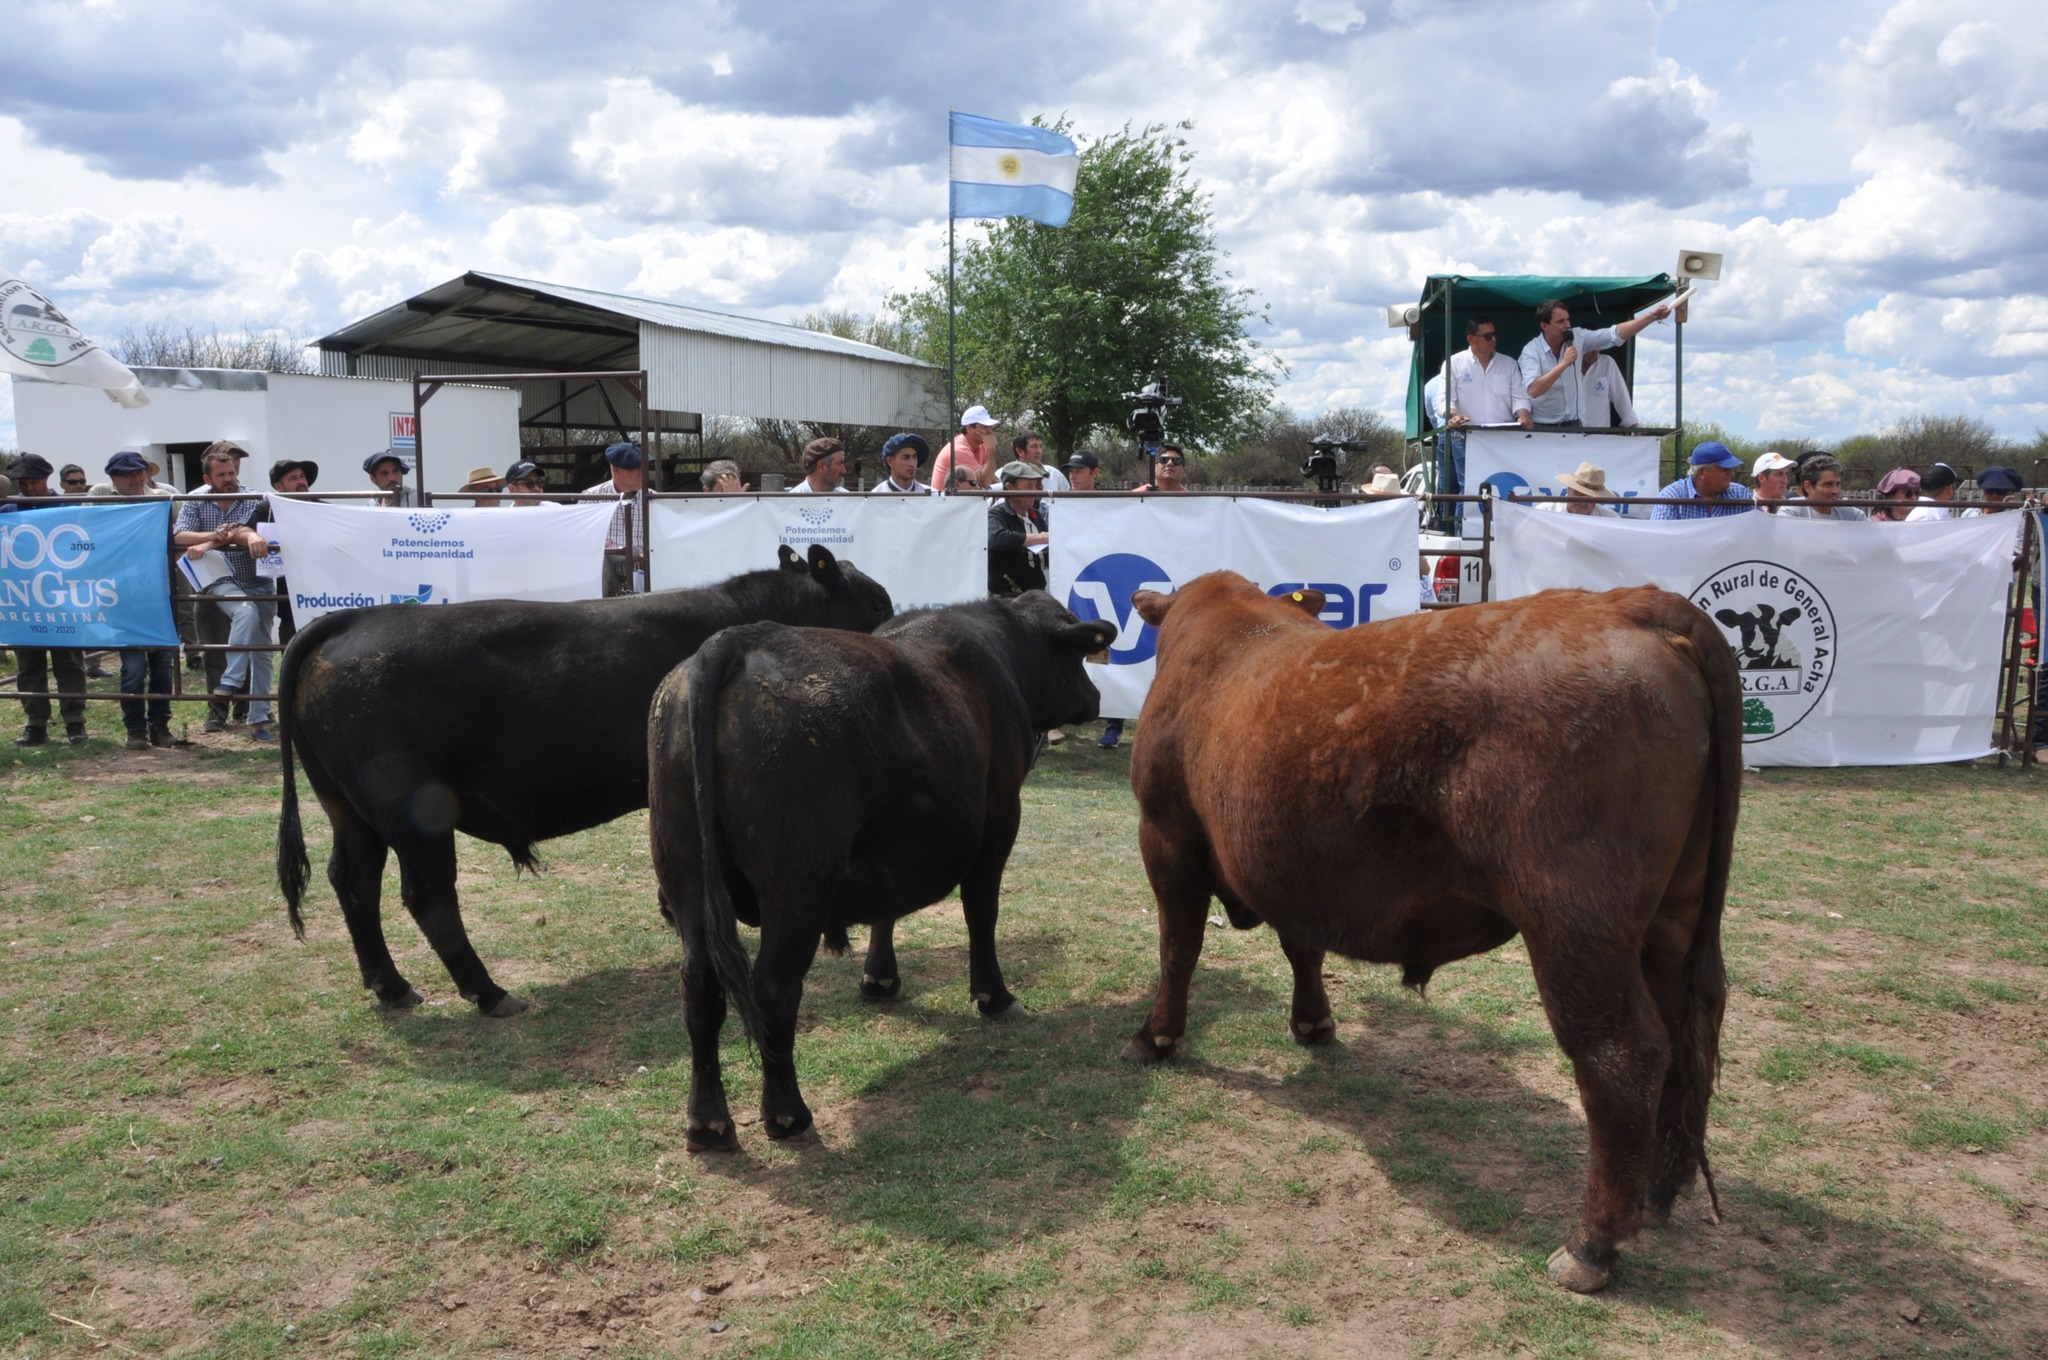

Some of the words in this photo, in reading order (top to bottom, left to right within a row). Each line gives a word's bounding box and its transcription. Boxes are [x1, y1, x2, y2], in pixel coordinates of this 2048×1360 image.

[393, 416, 416, 436] INTA
[785, 526, 846, 534] Potenciemos
[70, 541, 96, 550] años
[391, 538, 465, 547] Potenciemos
[789, 535, 854, 544] pampeanidad
[383, 549, 393, 557] la
[396, 549, 474, 560] pampeanidad
[1710, 569, 1754, 600] Rural
[1759, 570, 1779, 588] de
[296, 592, 375, 608] Producción
[1784, 577, 1830, 642] General
[1803, 647, 1829, 694] Acha
